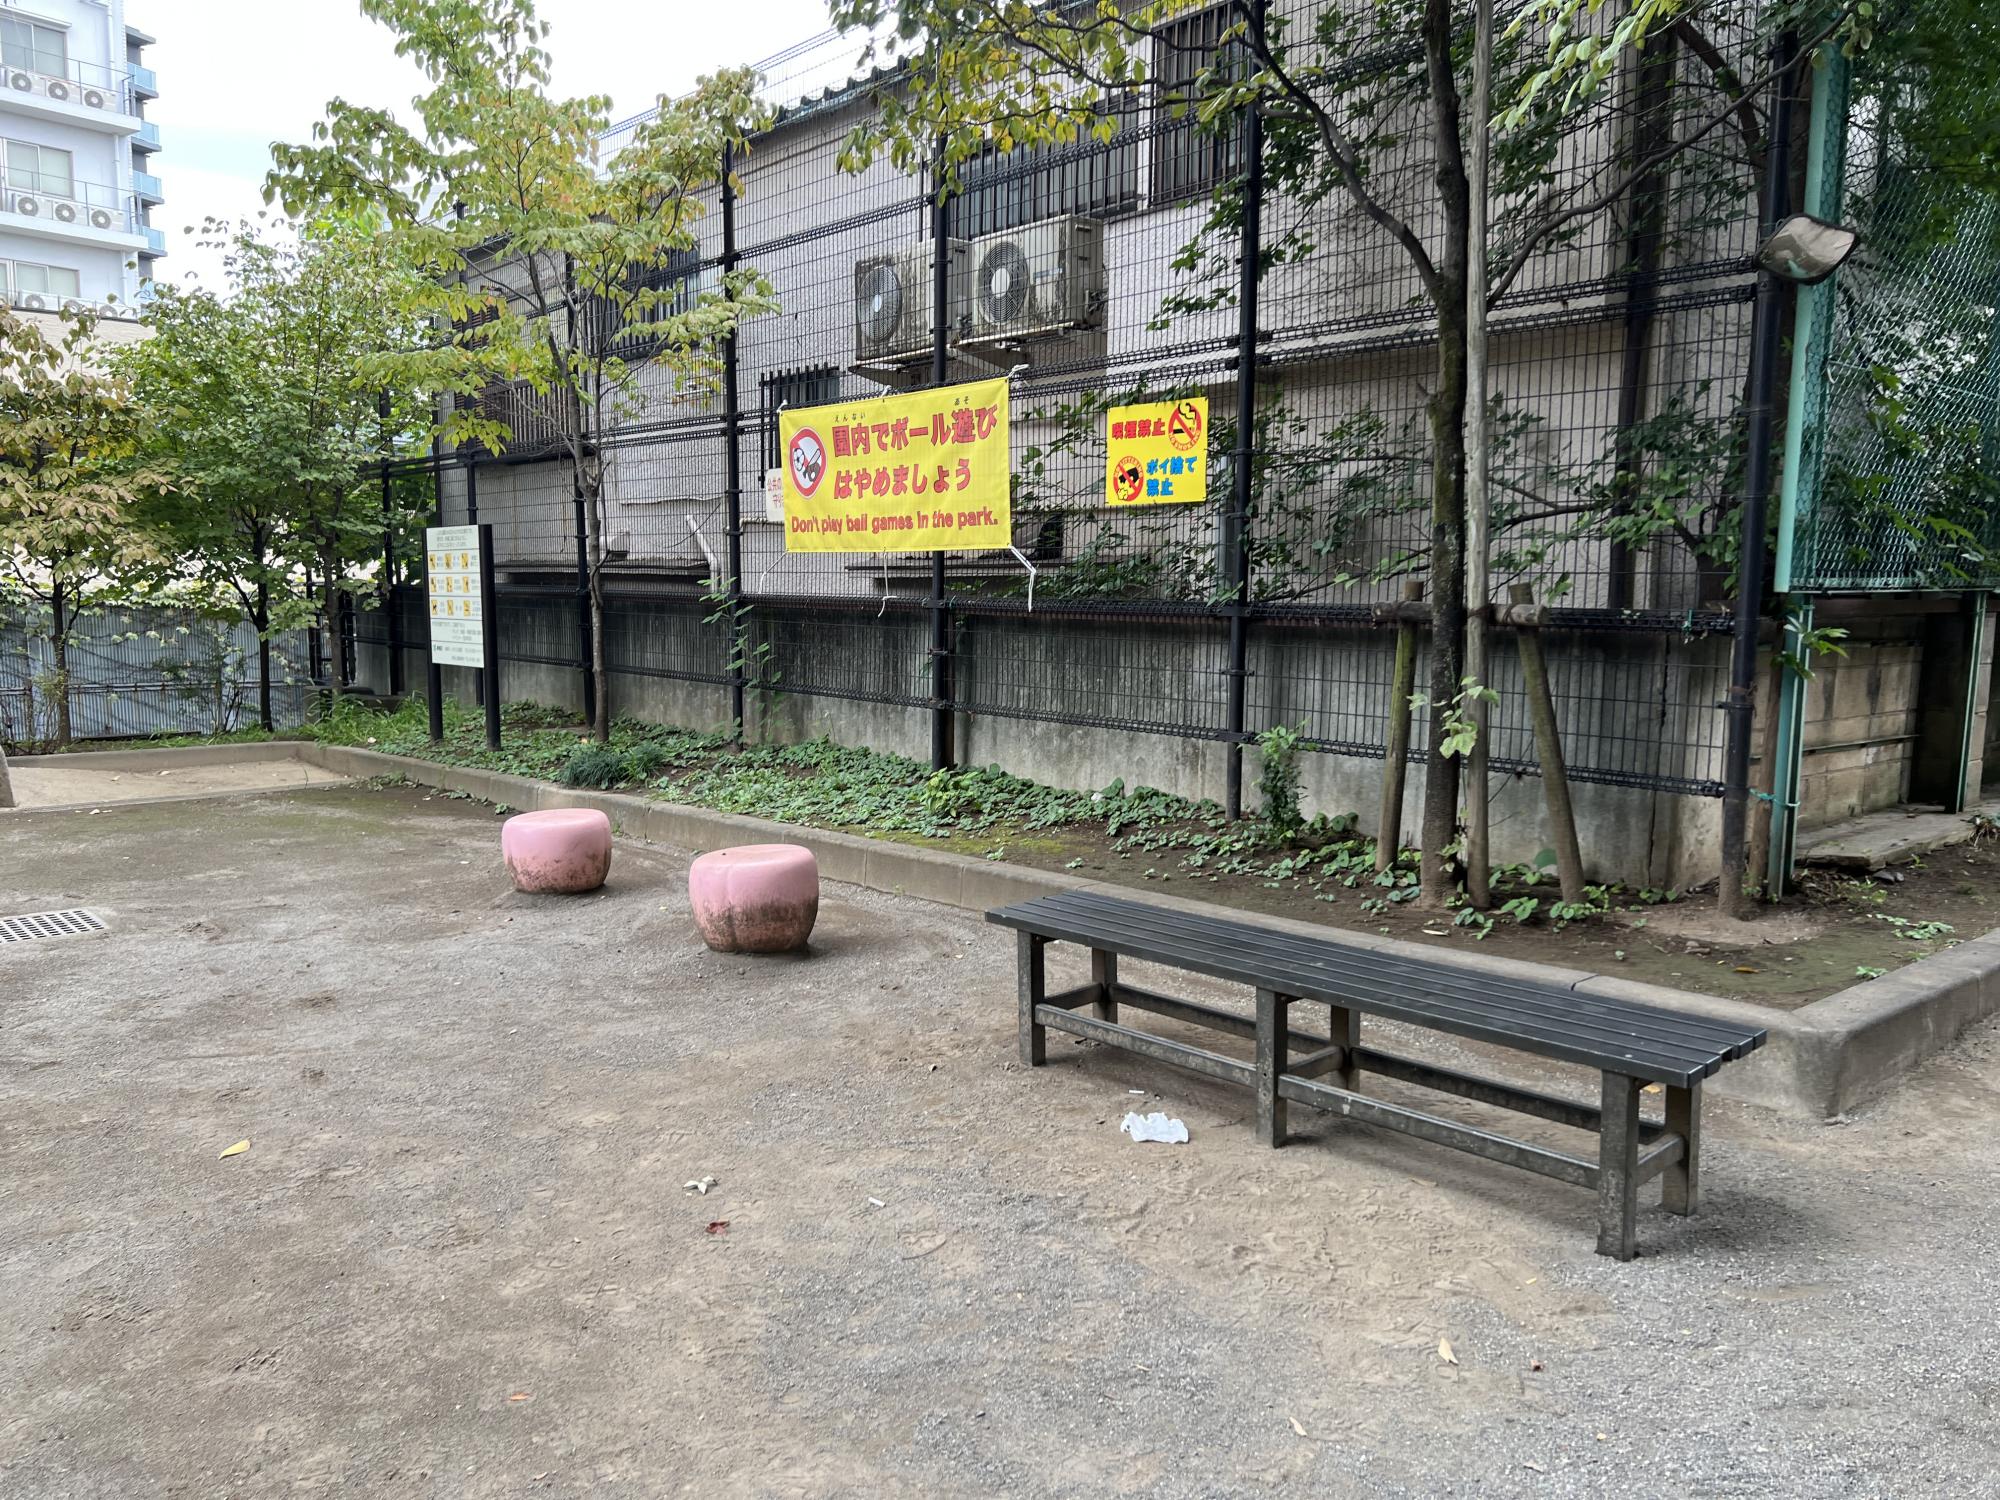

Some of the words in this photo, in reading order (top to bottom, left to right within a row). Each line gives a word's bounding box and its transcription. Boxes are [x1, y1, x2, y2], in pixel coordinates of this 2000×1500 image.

[832, 404, 998, 457] 園内でボール遊び
[1111, 418, 1166, 440] 喫煙禁止
[1146, 456, 1198, 475] ポイ捨て
[834, 458, 971, 499] はやめましょう
[1146, 478, 1174, 497] 禁止
[791, 515, 819, 533] Don't
[821, 515, 843, 535] play
[846, 513, 868, 532] ball
[871, 514, 914, 534] games
[917, 511, 929, 529] in
[932, 509, 954, 528] the
[957, 506, 999, 530] park.
